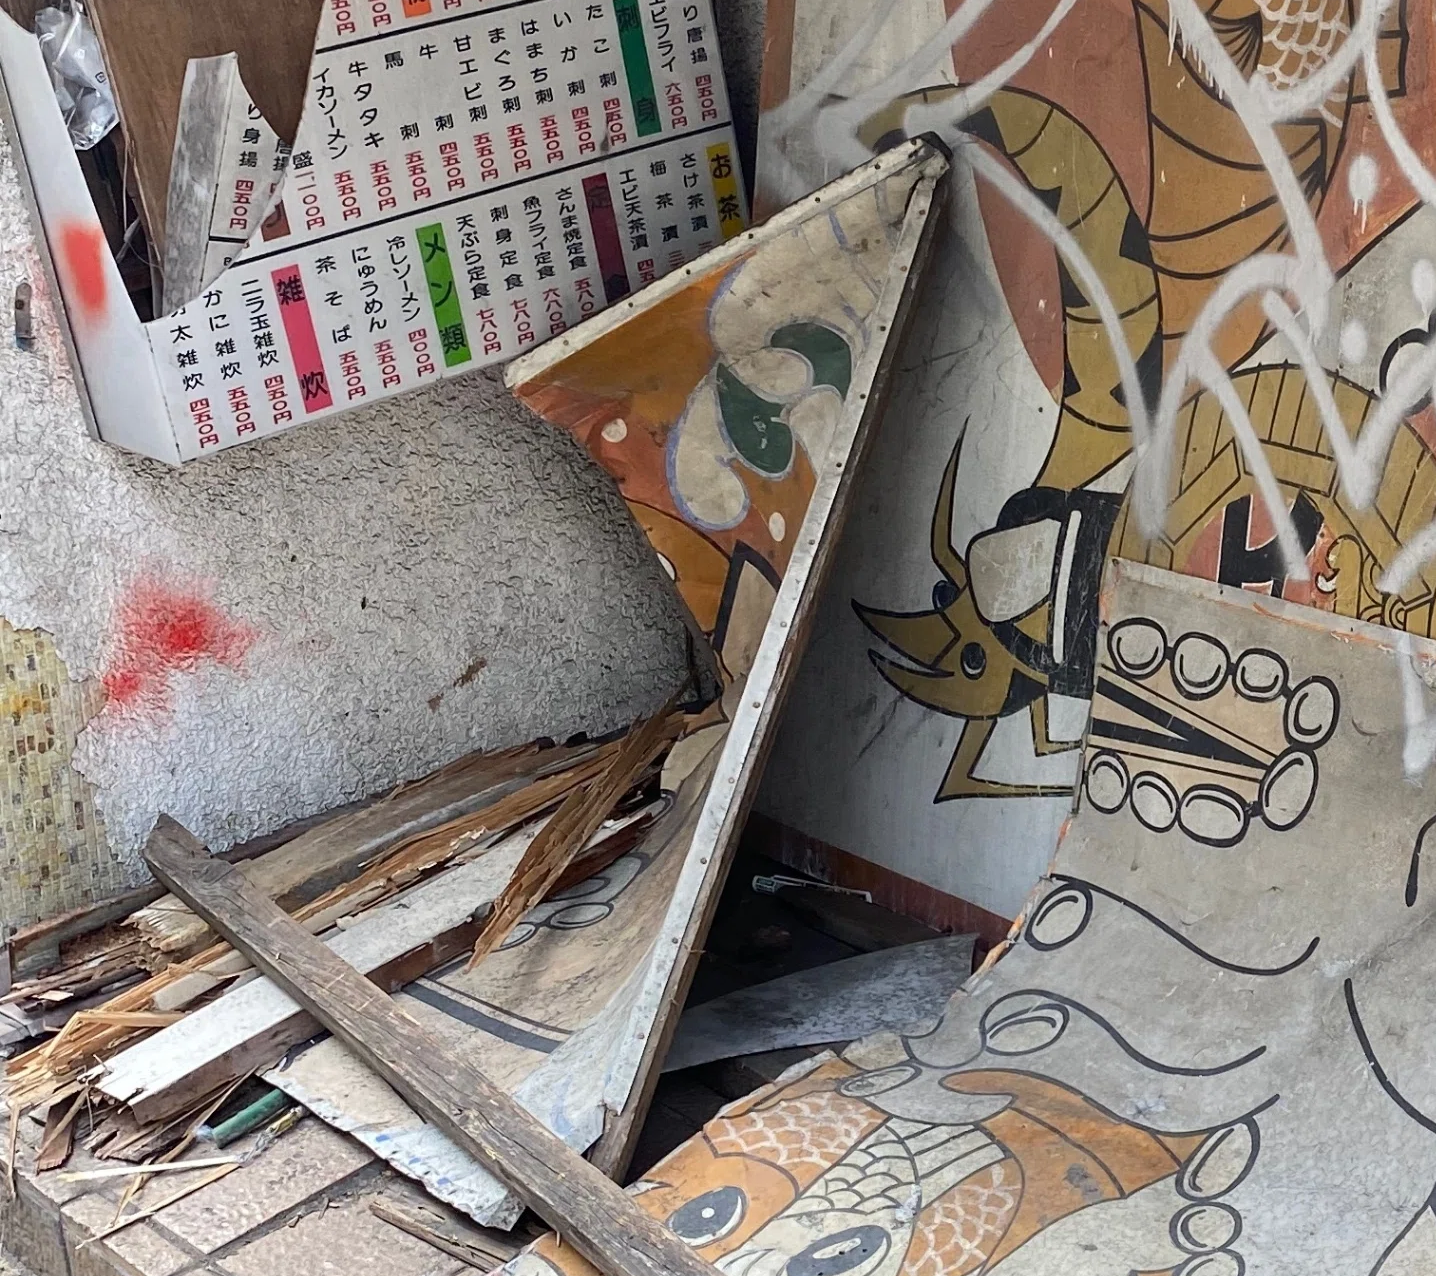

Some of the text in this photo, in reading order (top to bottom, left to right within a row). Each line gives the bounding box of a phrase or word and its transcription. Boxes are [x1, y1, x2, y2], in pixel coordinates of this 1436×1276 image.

[420, 44, 453, 131] 牛刺
[453, 35, 487, 122] 甘エビ刺
[488, 28, 521, 113] まぐろ刺
[521, 19, 553, 104] はまち刺
[554, 12, 585, 97] いか刺
[586, 5, 617, 88] たこ刺
[616, 4, 656, 121] 刺身
[308, 68, 347, 159] イカソーメン
[349, 61, 384, 147] 牛タタキ
[385, 51, 419, 140] 馬刺
[456, 214, 490, 300] 天ぷら定食
[490, 205, 523, 291] 刺身定食
[523, 196, 555, 280] 魚フライ定食
[555, 187, 587, 270] さんま焼定食
[315, 256, 352, 343] 茶そば
[352, 247, 387, 332] にゅうめん
[386, 236, 420, 322] 冷しソーメン
[423, 233, 467, 354] メン類
[170, 308, 204, 391] 太雑炊
[203, 290, 242, 380] かに雑炊
[242, 279, 279, 368] ニラ玉雑炊
[275, 275, 328, 401] 雑炊
